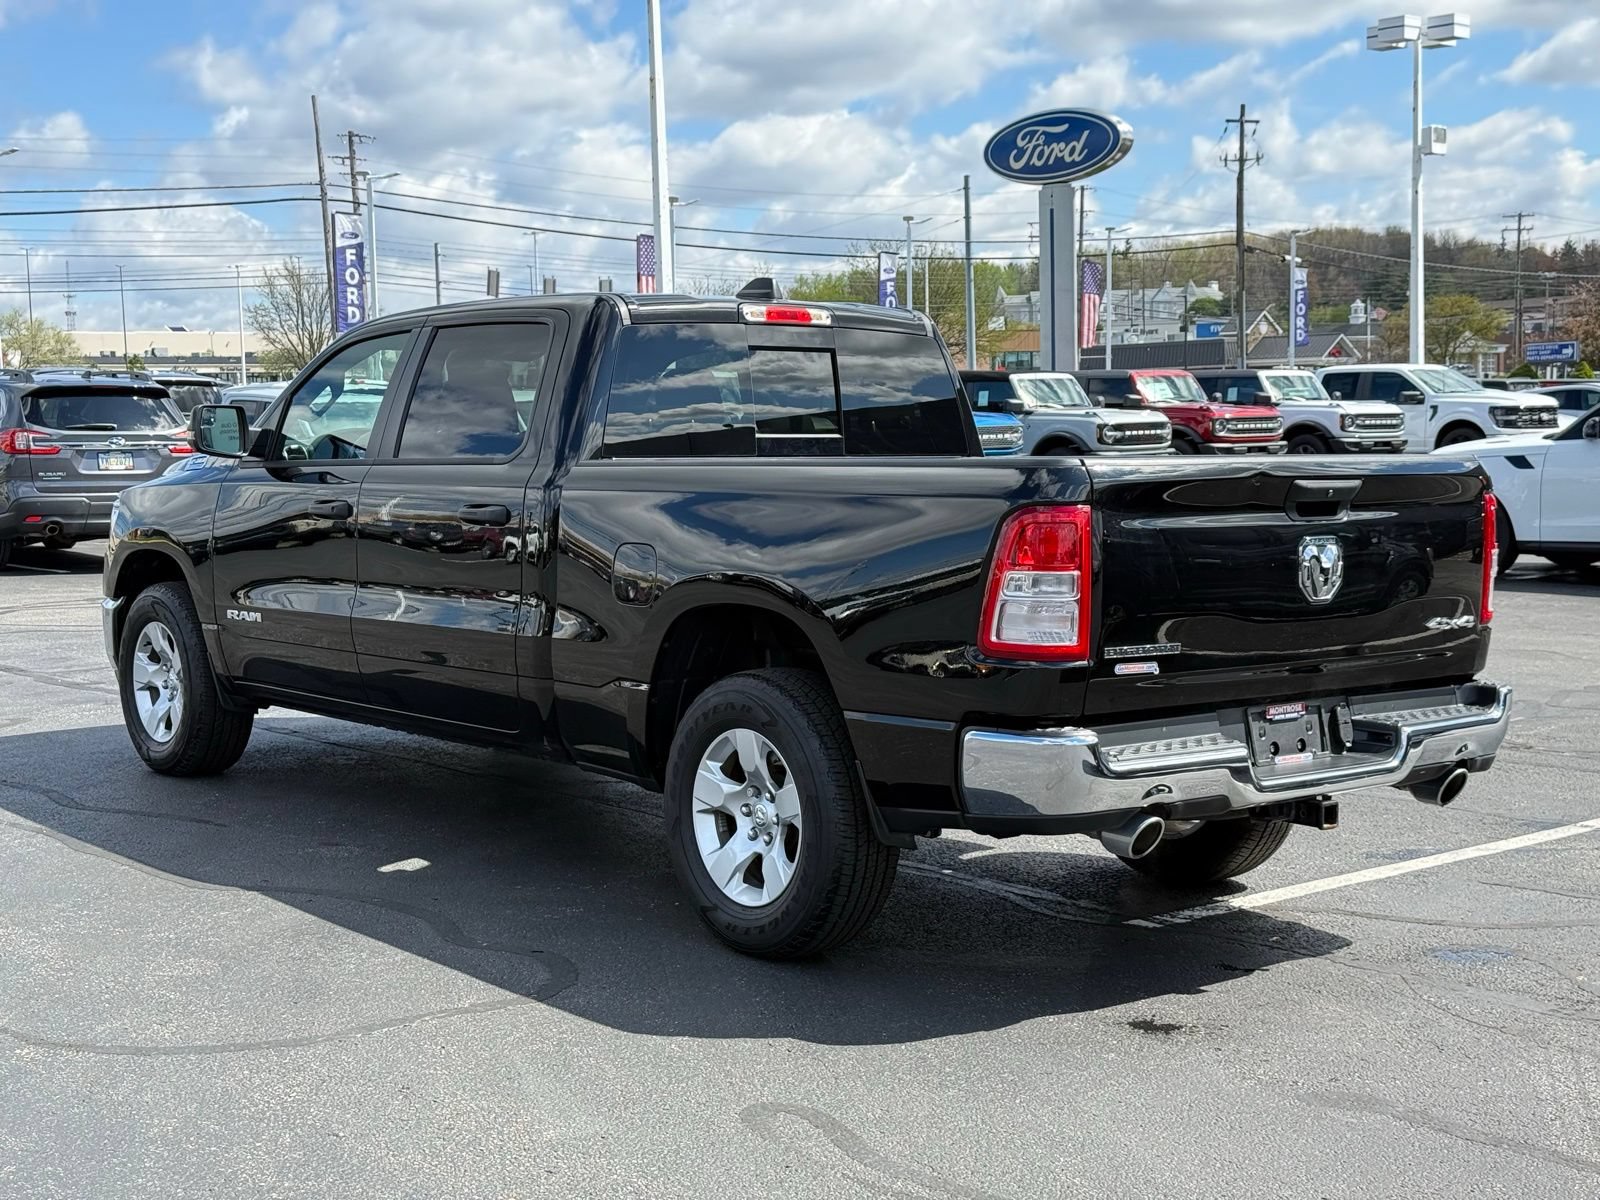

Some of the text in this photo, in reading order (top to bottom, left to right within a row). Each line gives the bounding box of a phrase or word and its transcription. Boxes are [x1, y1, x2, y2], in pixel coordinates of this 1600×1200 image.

[1009, 123, 1090, 170] Ford
[345, 248, 361, 324] FORD
[886, 281, 896, 308] FO
[1210, 324, 1226, 333] fiv
[1296, 290, 1307, 341] FORD
[226, 609, 262, 623] RAM
[1269, 704, 1303, 714] MONTROSE
